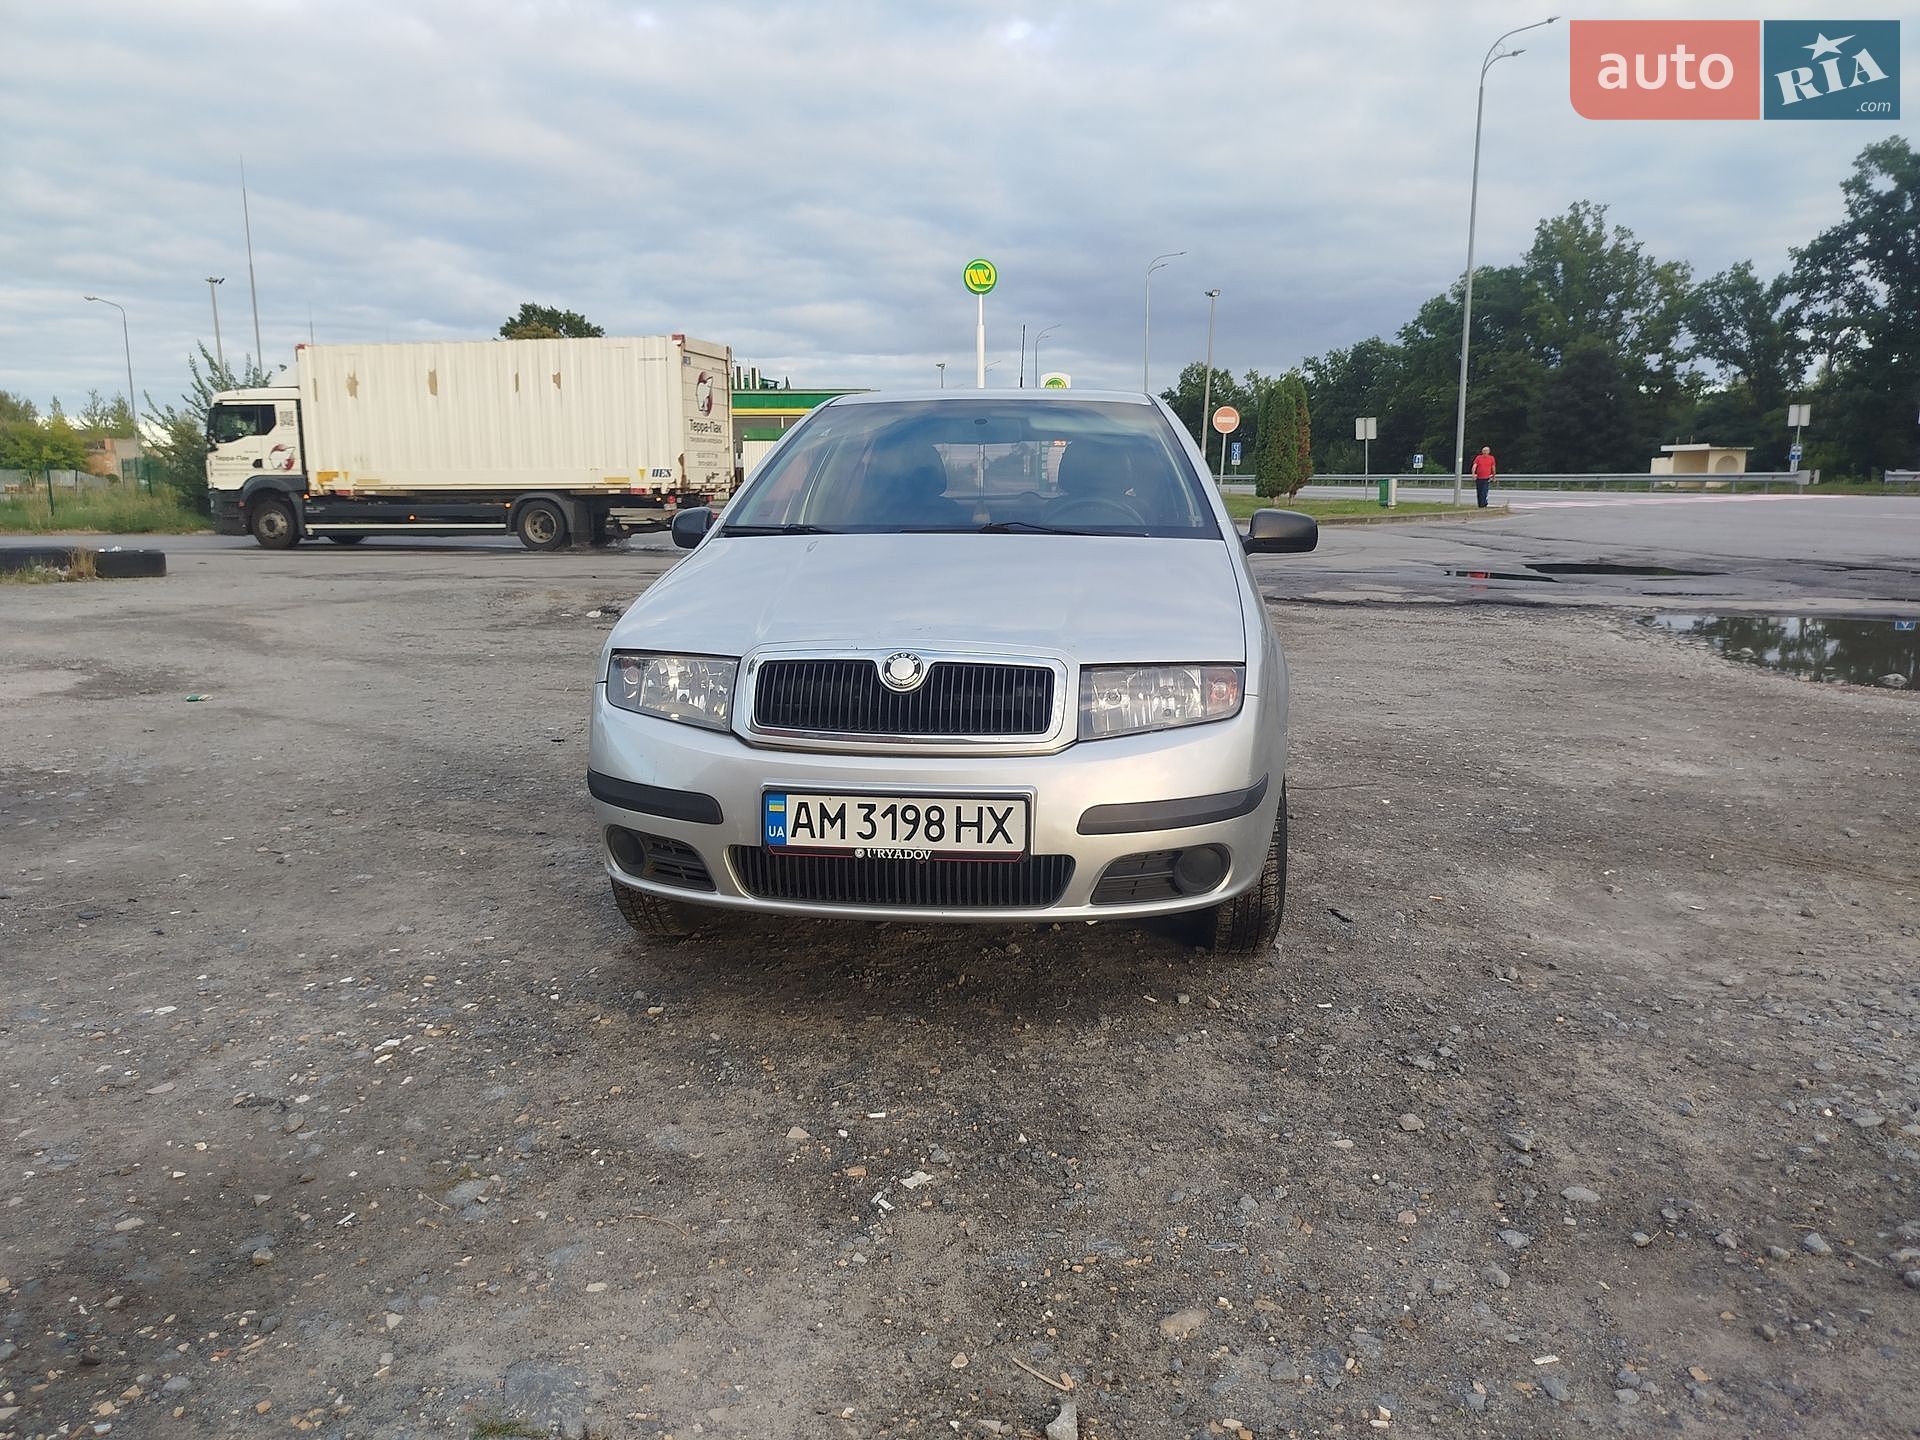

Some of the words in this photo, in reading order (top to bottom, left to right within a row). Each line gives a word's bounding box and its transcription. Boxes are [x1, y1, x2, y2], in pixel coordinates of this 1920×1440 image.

[768, 827, 785, 838] UA
[790, 801, 846, 840] AM
[856, 803, 946, 843] 3198
[955, 805, 1014, 845] HX
